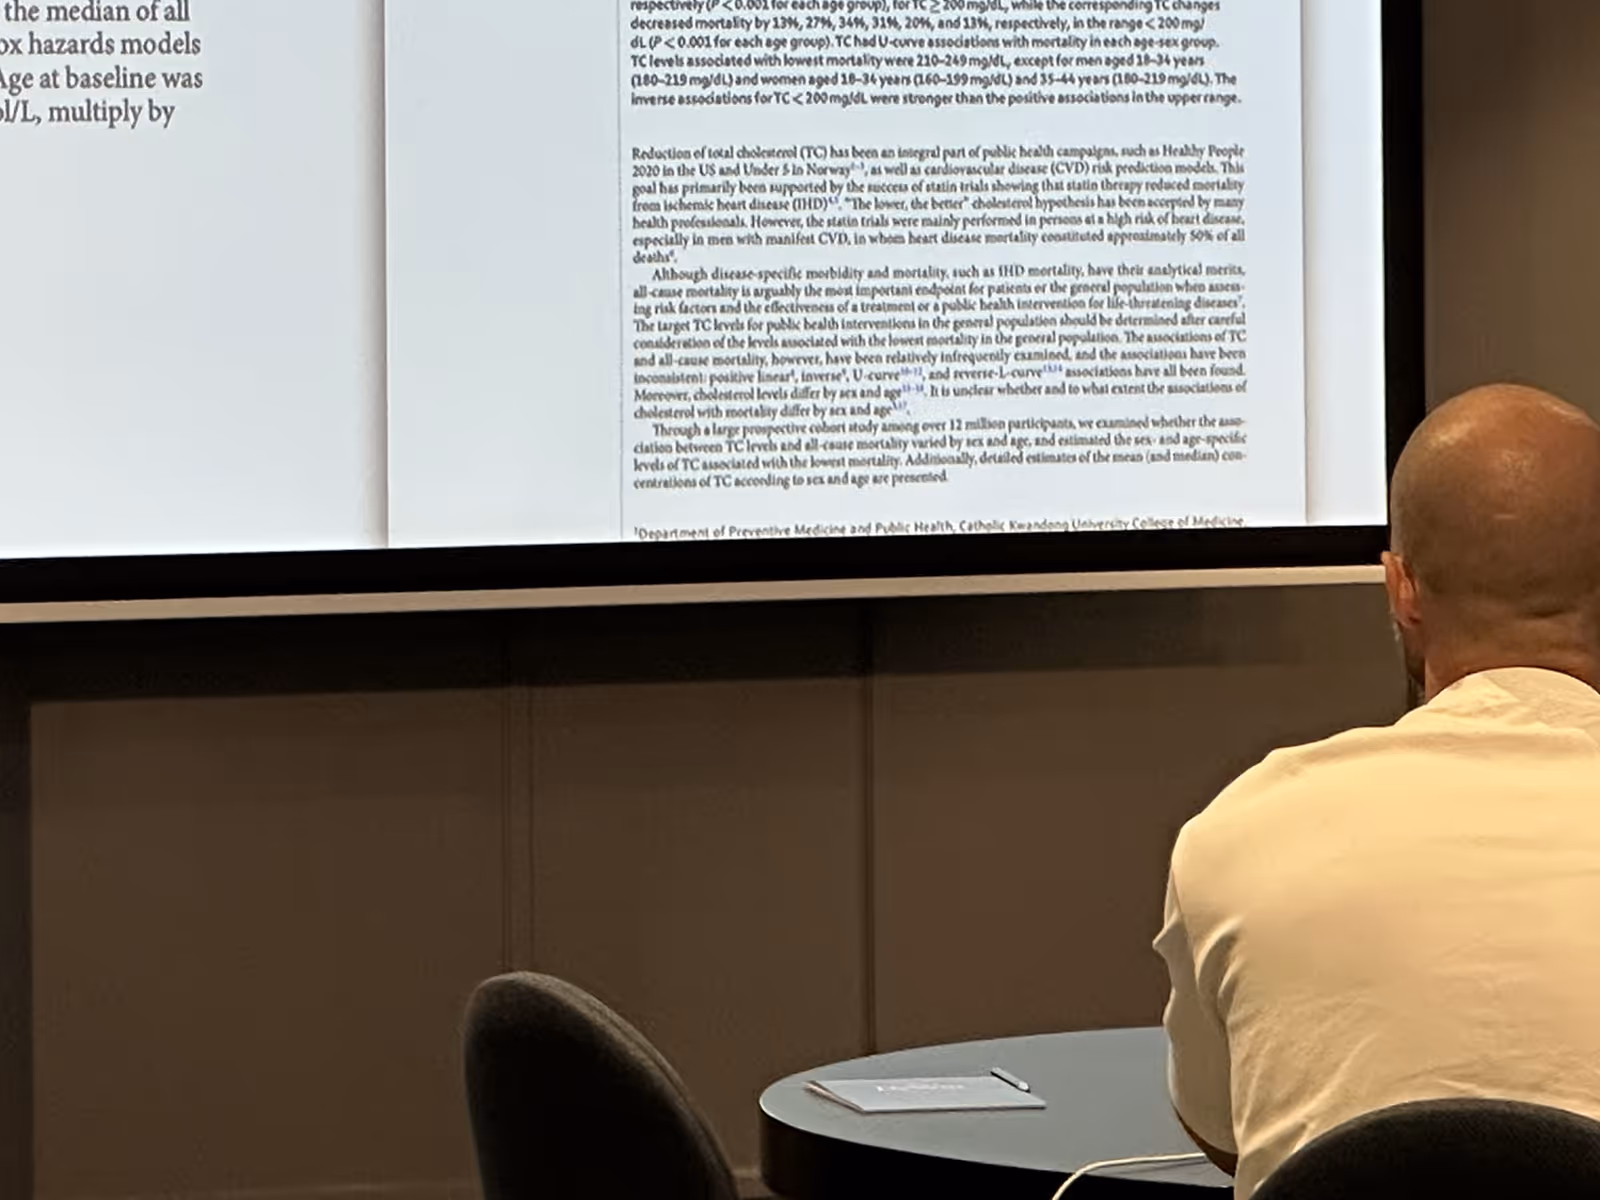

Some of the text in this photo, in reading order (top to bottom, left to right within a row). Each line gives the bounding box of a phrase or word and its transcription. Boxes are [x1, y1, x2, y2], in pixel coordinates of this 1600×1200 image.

[28, 30, 114, 56] hazards
[121, 30, 201, 56] models
[49, 97, 142, 130] multiply
[148, 98, 175, 129] by
